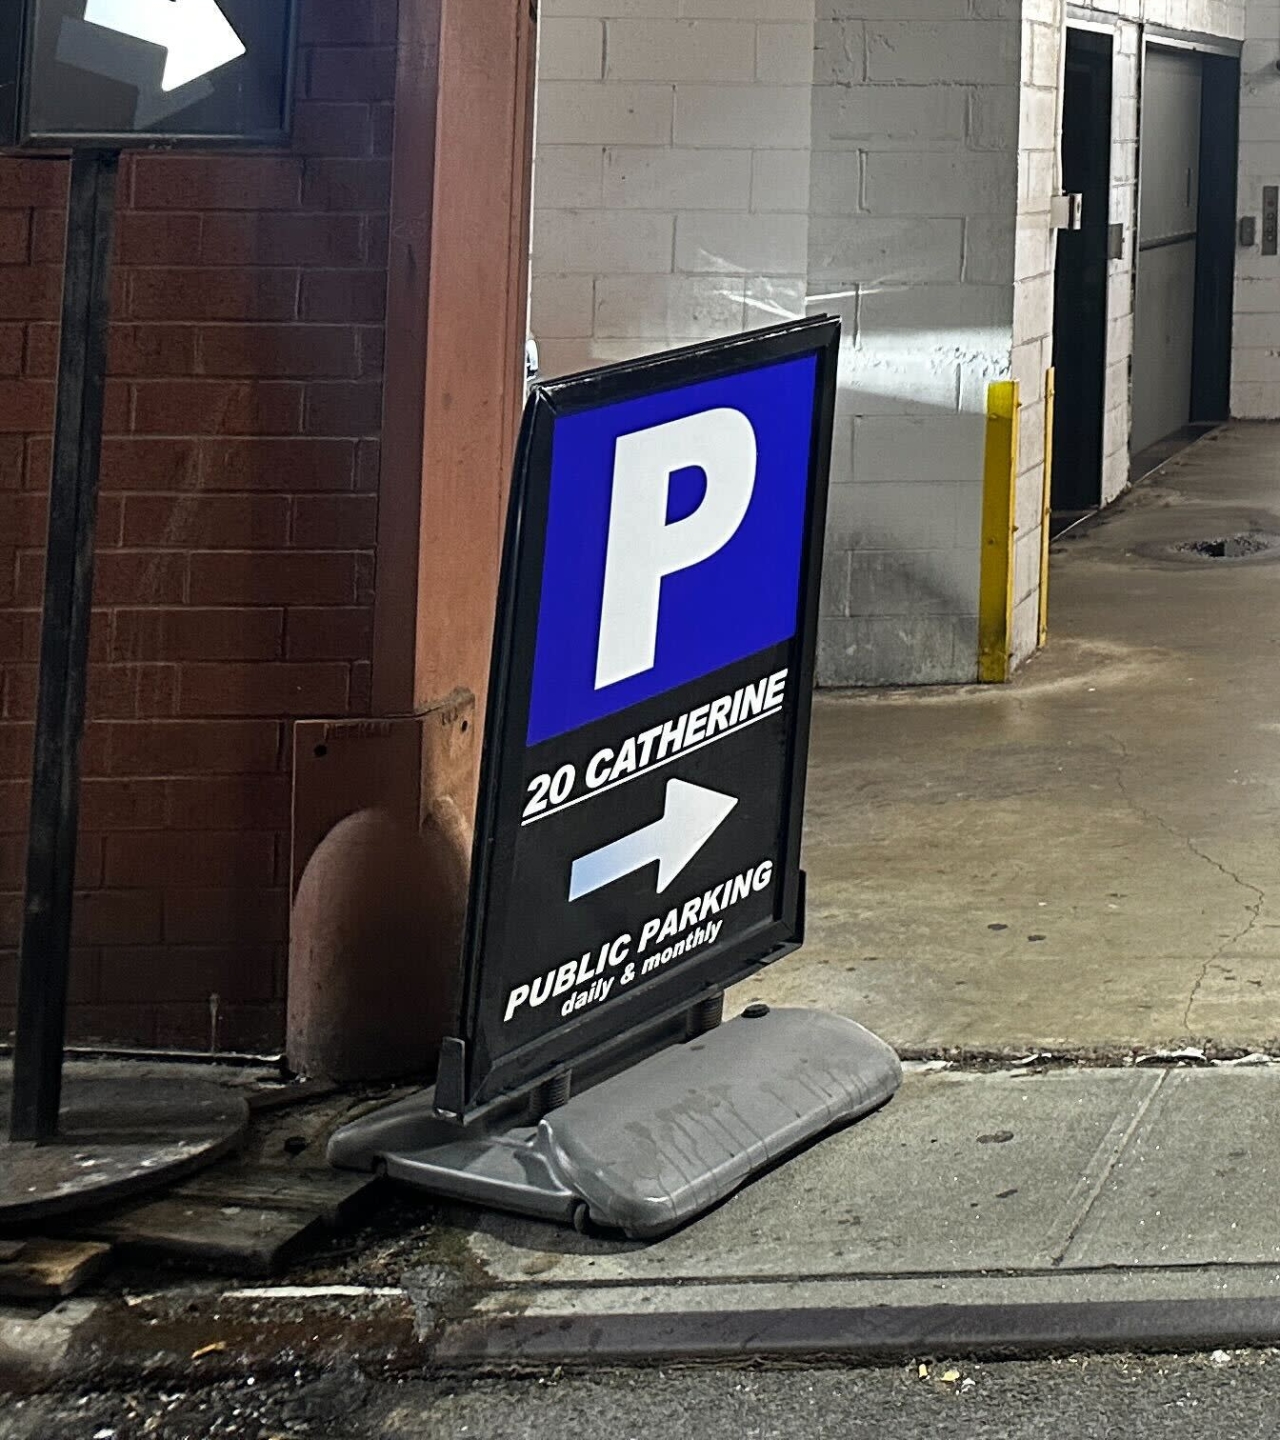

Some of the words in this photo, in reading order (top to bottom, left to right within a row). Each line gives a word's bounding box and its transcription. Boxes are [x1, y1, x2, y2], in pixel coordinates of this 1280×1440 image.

[594, 407, 757, 691] P
[522, 764, 576, 818] 20
[585, 668, 788, 789] CATHERINE
[504, 934, 632, 1022] PUBLIC
[637, 860, 773, 953] PARKING
[561, 976, 615, 1017] daily
[620, 963, 636, 985] &
[641, 919, 723, 975] monthly
